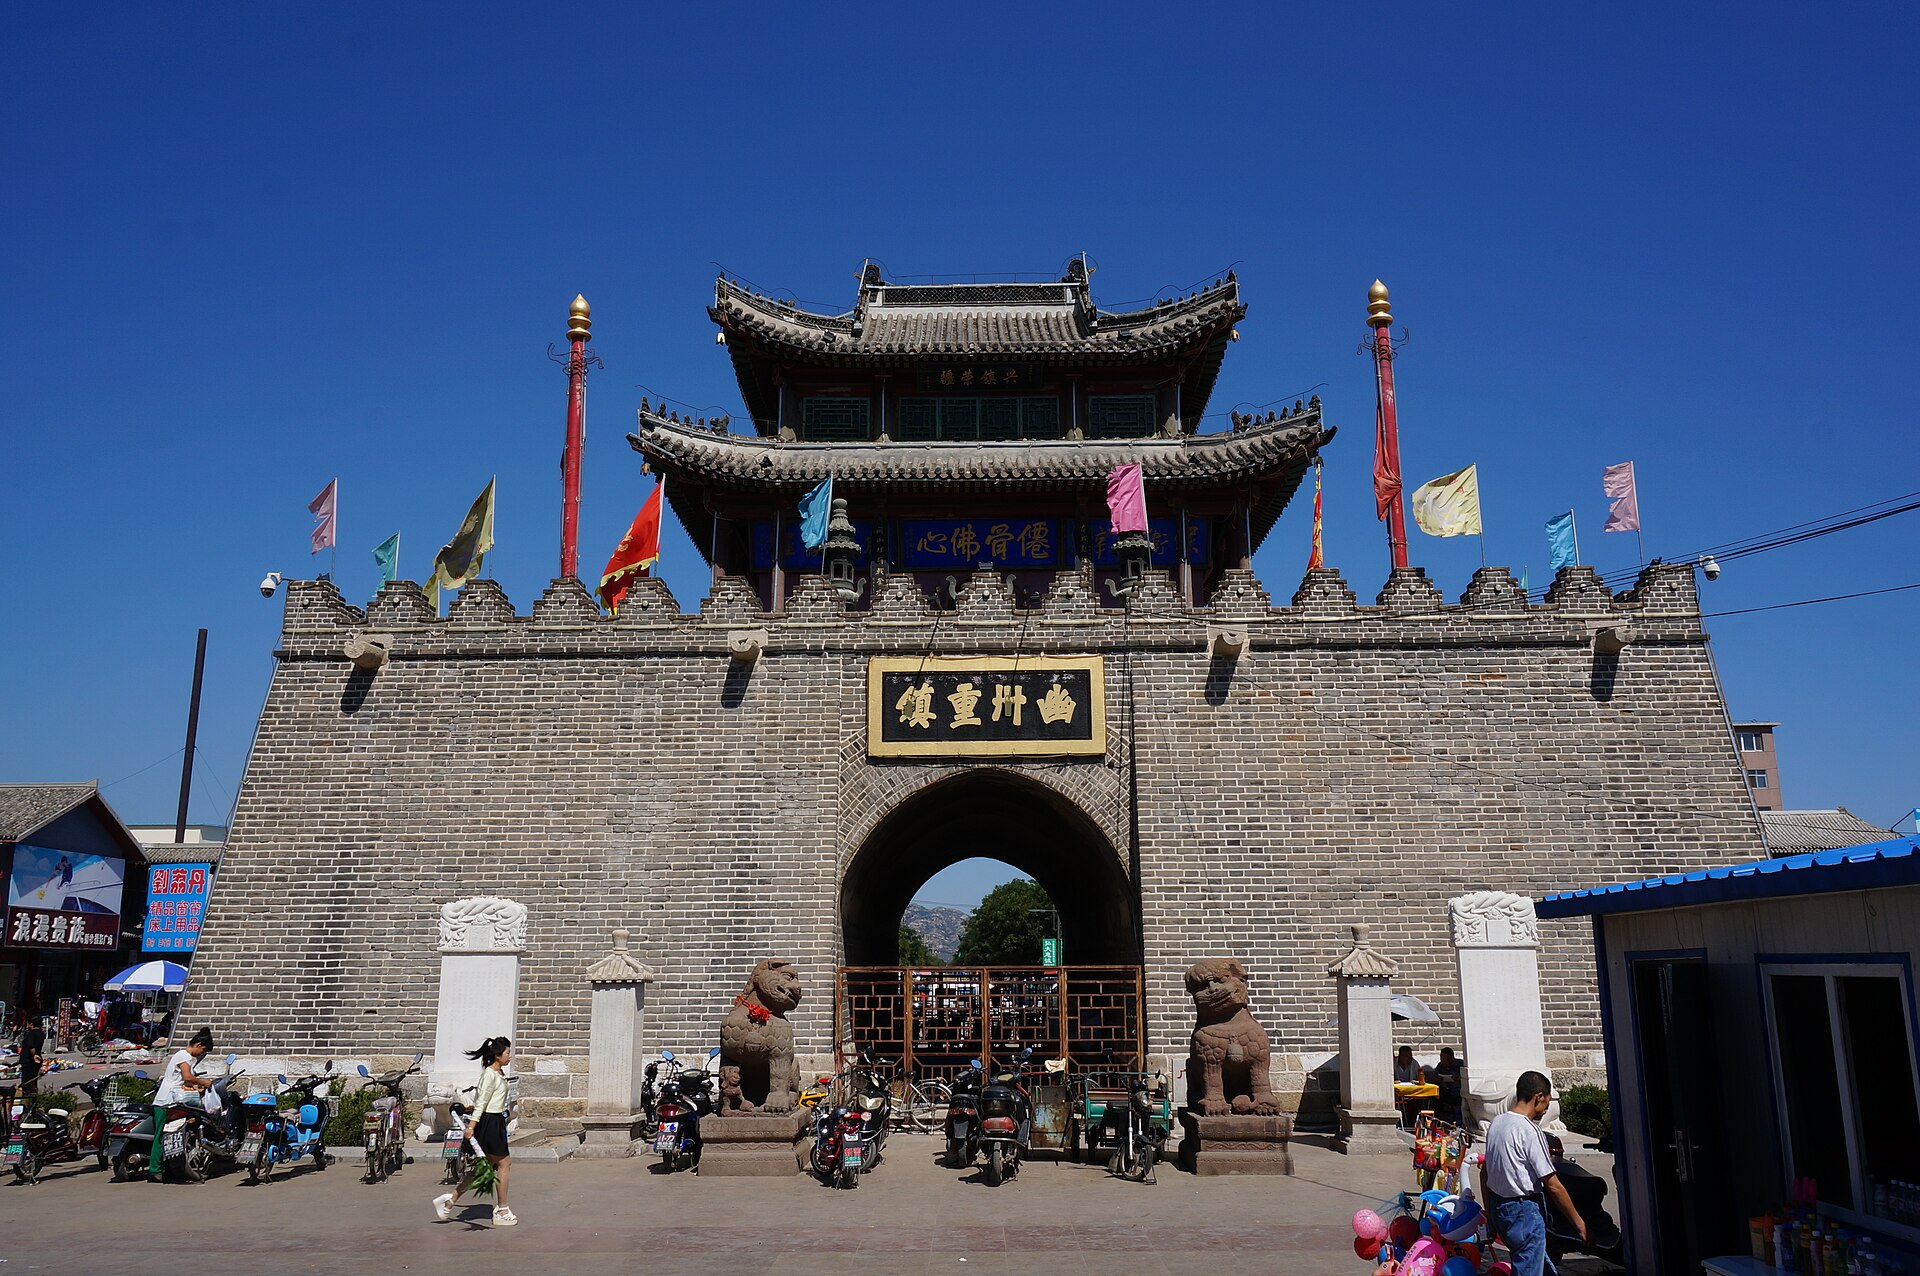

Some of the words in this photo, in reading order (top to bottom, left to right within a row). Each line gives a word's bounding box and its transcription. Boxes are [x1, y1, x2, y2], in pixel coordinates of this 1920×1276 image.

[12, 912, 86, 943] 浪漫贵族
[147, 917, 200, 932] 床上用品
